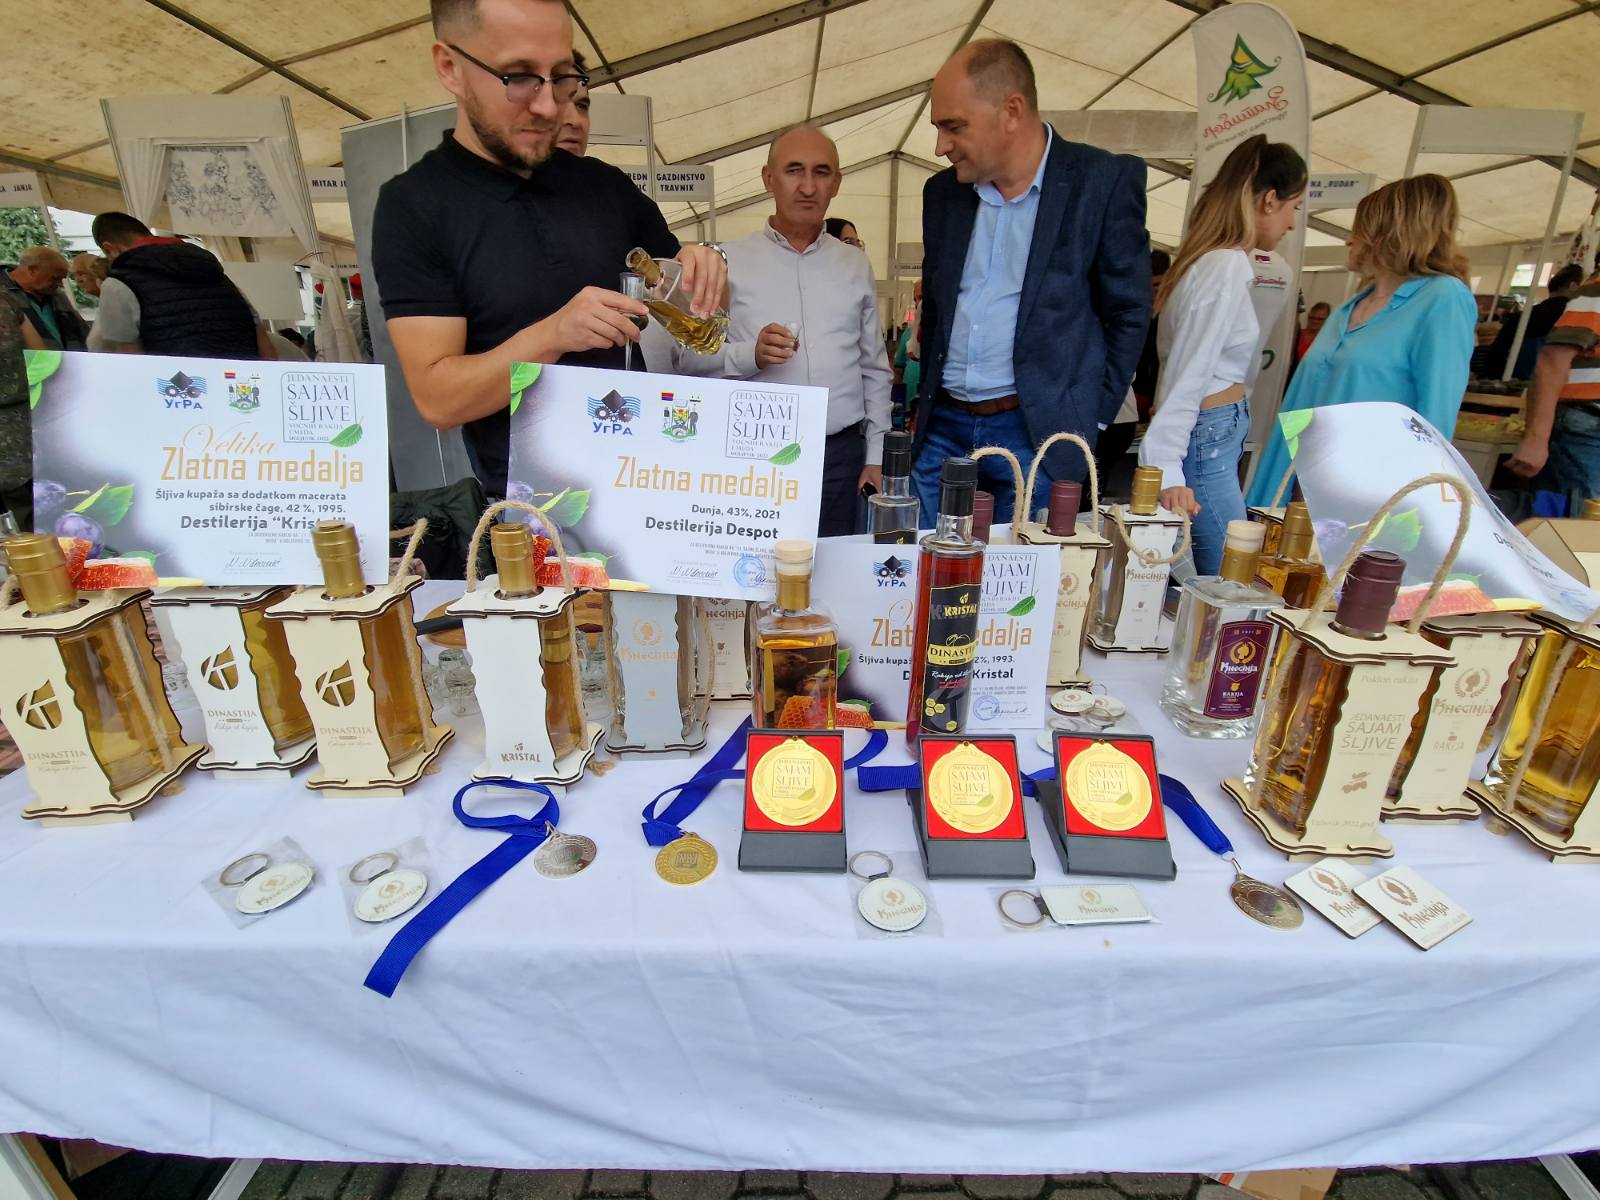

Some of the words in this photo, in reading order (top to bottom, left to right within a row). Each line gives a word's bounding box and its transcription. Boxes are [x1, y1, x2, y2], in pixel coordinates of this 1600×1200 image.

[656, 173, 706, 181] GAZDINSTVO
[660, 184, 694, 192] TRAVNIK
[287, 383, 349, 402] SAJAM
[288, 400, 351, 424] ŠLJIVE
[734, 401, 792, 420] SAJAM
[732, 417, 791, 440] ŠLJIVE
[183, 422, 276, 456] Velika
[161, 446, 247, 481] Zlatna
[258, 448, 364, 490] medalja
[614, 455, 691, 492] Zlatna
[700, 465, 799, 507] medalja
[155, 490, 185, 501] Šljiva
[187, 490, 225, 500] kupaža
[241, 490, 296, 500] dodatkom
[298, 493, 347, 501] macerata
[209, 503, 253, 512] sibirske
[255, 503, 283, 515] čage,
[286, 504, 300, 513] 42
[318, 504, 347, 513] 1995.
[691, 504, 724, 516] Dunja,
[726, 507, 752, 518] 43%,
[755, 509, 781, 519] 2021
[181, 515, 268, 532] Destilerija
[645, 516, 723, 536] Destilerija
[726, 522, 779, 541] Despot
[988, 554, 1033, 562] DANAESTI
[984, 563, 1030, 579] AJAM
[982, 581, 1028, 597] LJIVE
[871, 618, 914, 647] Zlat
[976, 618, 1033, 652] edalja
[859, 656, 885, 665] Šljiva
[886, 657, 912, 666] kupa
[974, 656, 990, 664] 2%,
[992, 655, 1015, 663] 1993.
[973, 668, 1014, 680] Kristal
[1345, 721, 1402, 734] SAJAM
[1341, 734, 1399, 751] ŠLJIVE
[501, 753, 541, 763] KRISTAL
